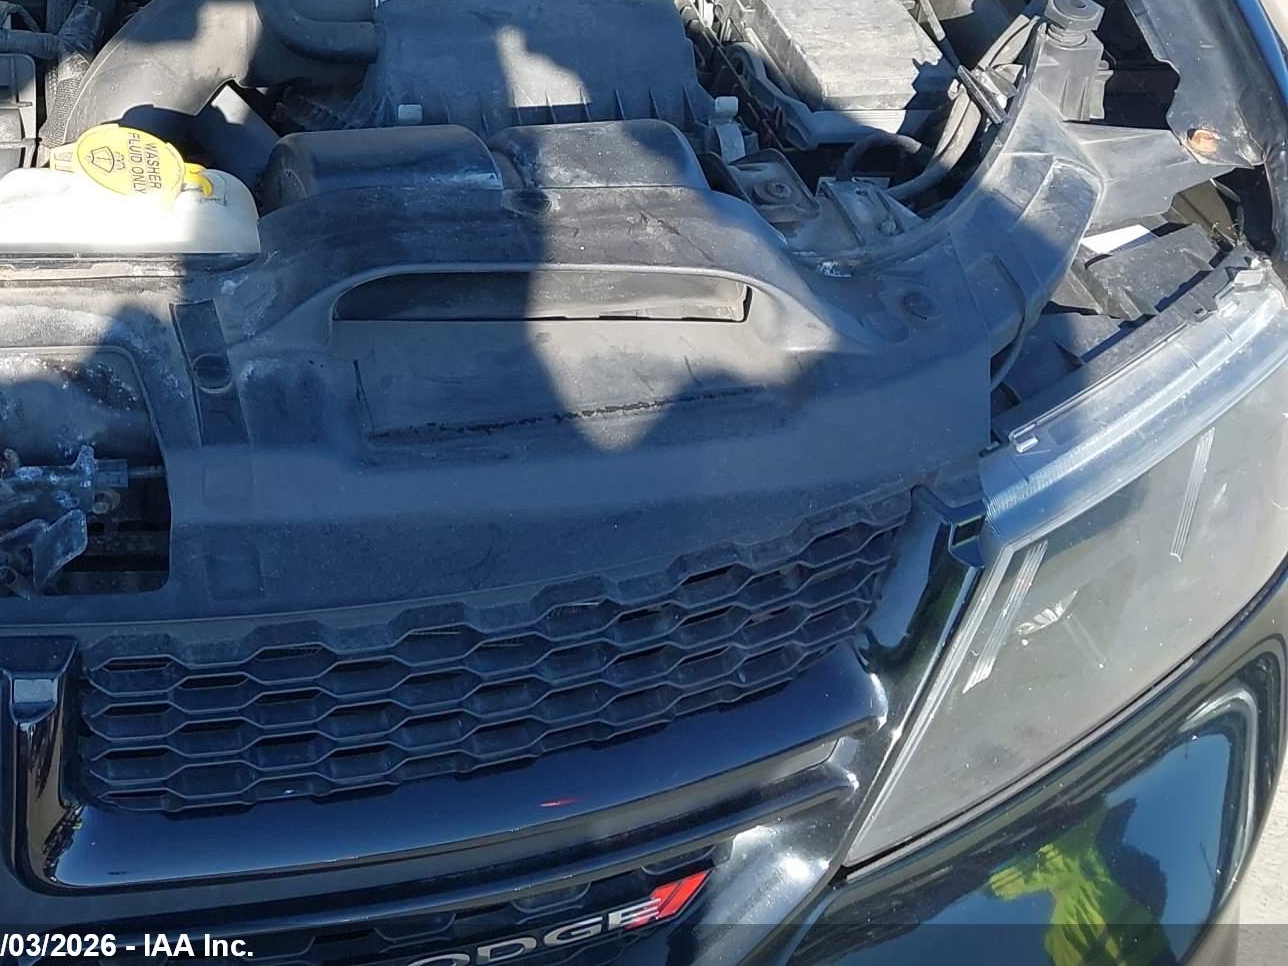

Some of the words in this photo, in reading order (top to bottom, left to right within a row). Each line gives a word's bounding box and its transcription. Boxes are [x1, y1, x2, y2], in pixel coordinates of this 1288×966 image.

[127, 132, 143, 164] FLUID
[131, 166, 147, 194] ONLY
[145, 142, 162, 190] WASHER
